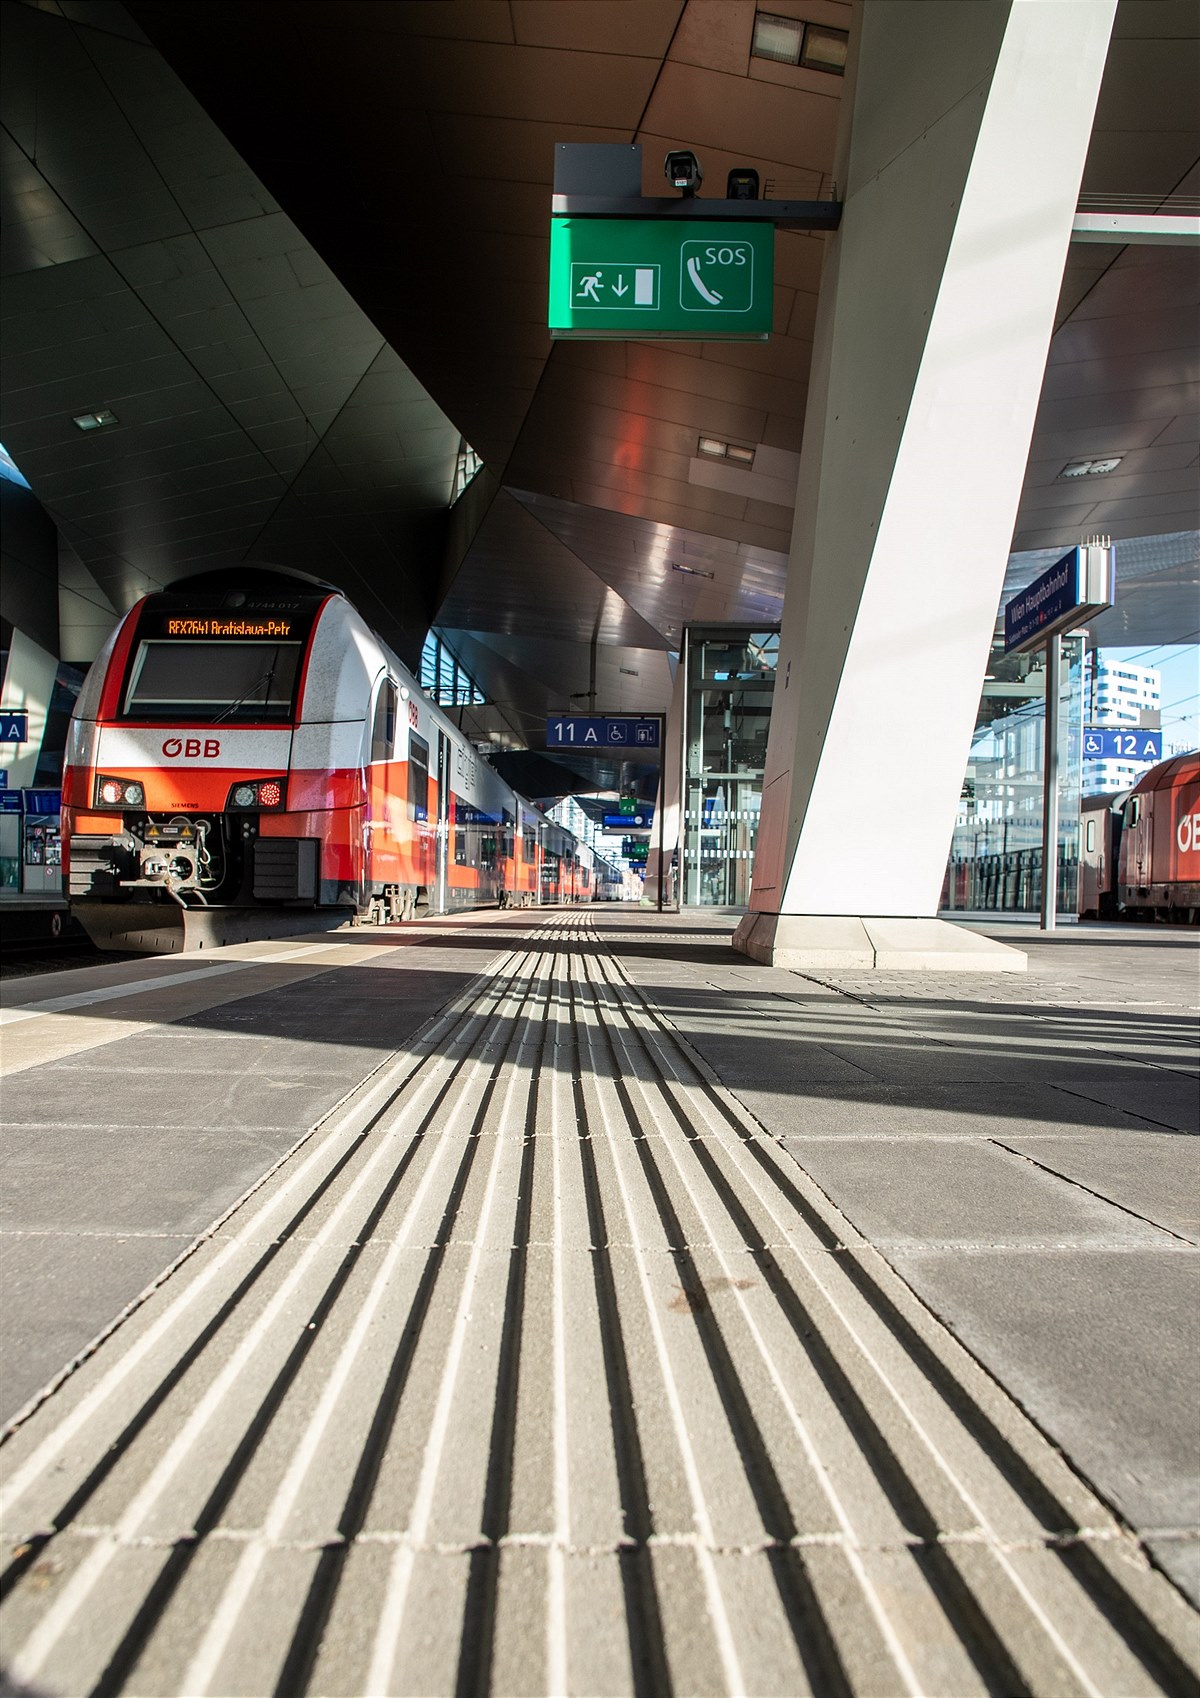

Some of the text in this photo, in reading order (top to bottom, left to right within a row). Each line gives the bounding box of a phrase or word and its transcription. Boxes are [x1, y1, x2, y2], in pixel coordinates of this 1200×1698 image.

[705, 247, 746, 266] SOS
[1011, 599, 1025, 624] Wien
[1025, 563, 1068, 614] Hauptbahnhof
[8, 724, 20, 737] A
[555, 722, 598, 742] 11 A
[162, 738, 221, 758] ÖBB
[1113, 735, 1157, 755] 12 A
